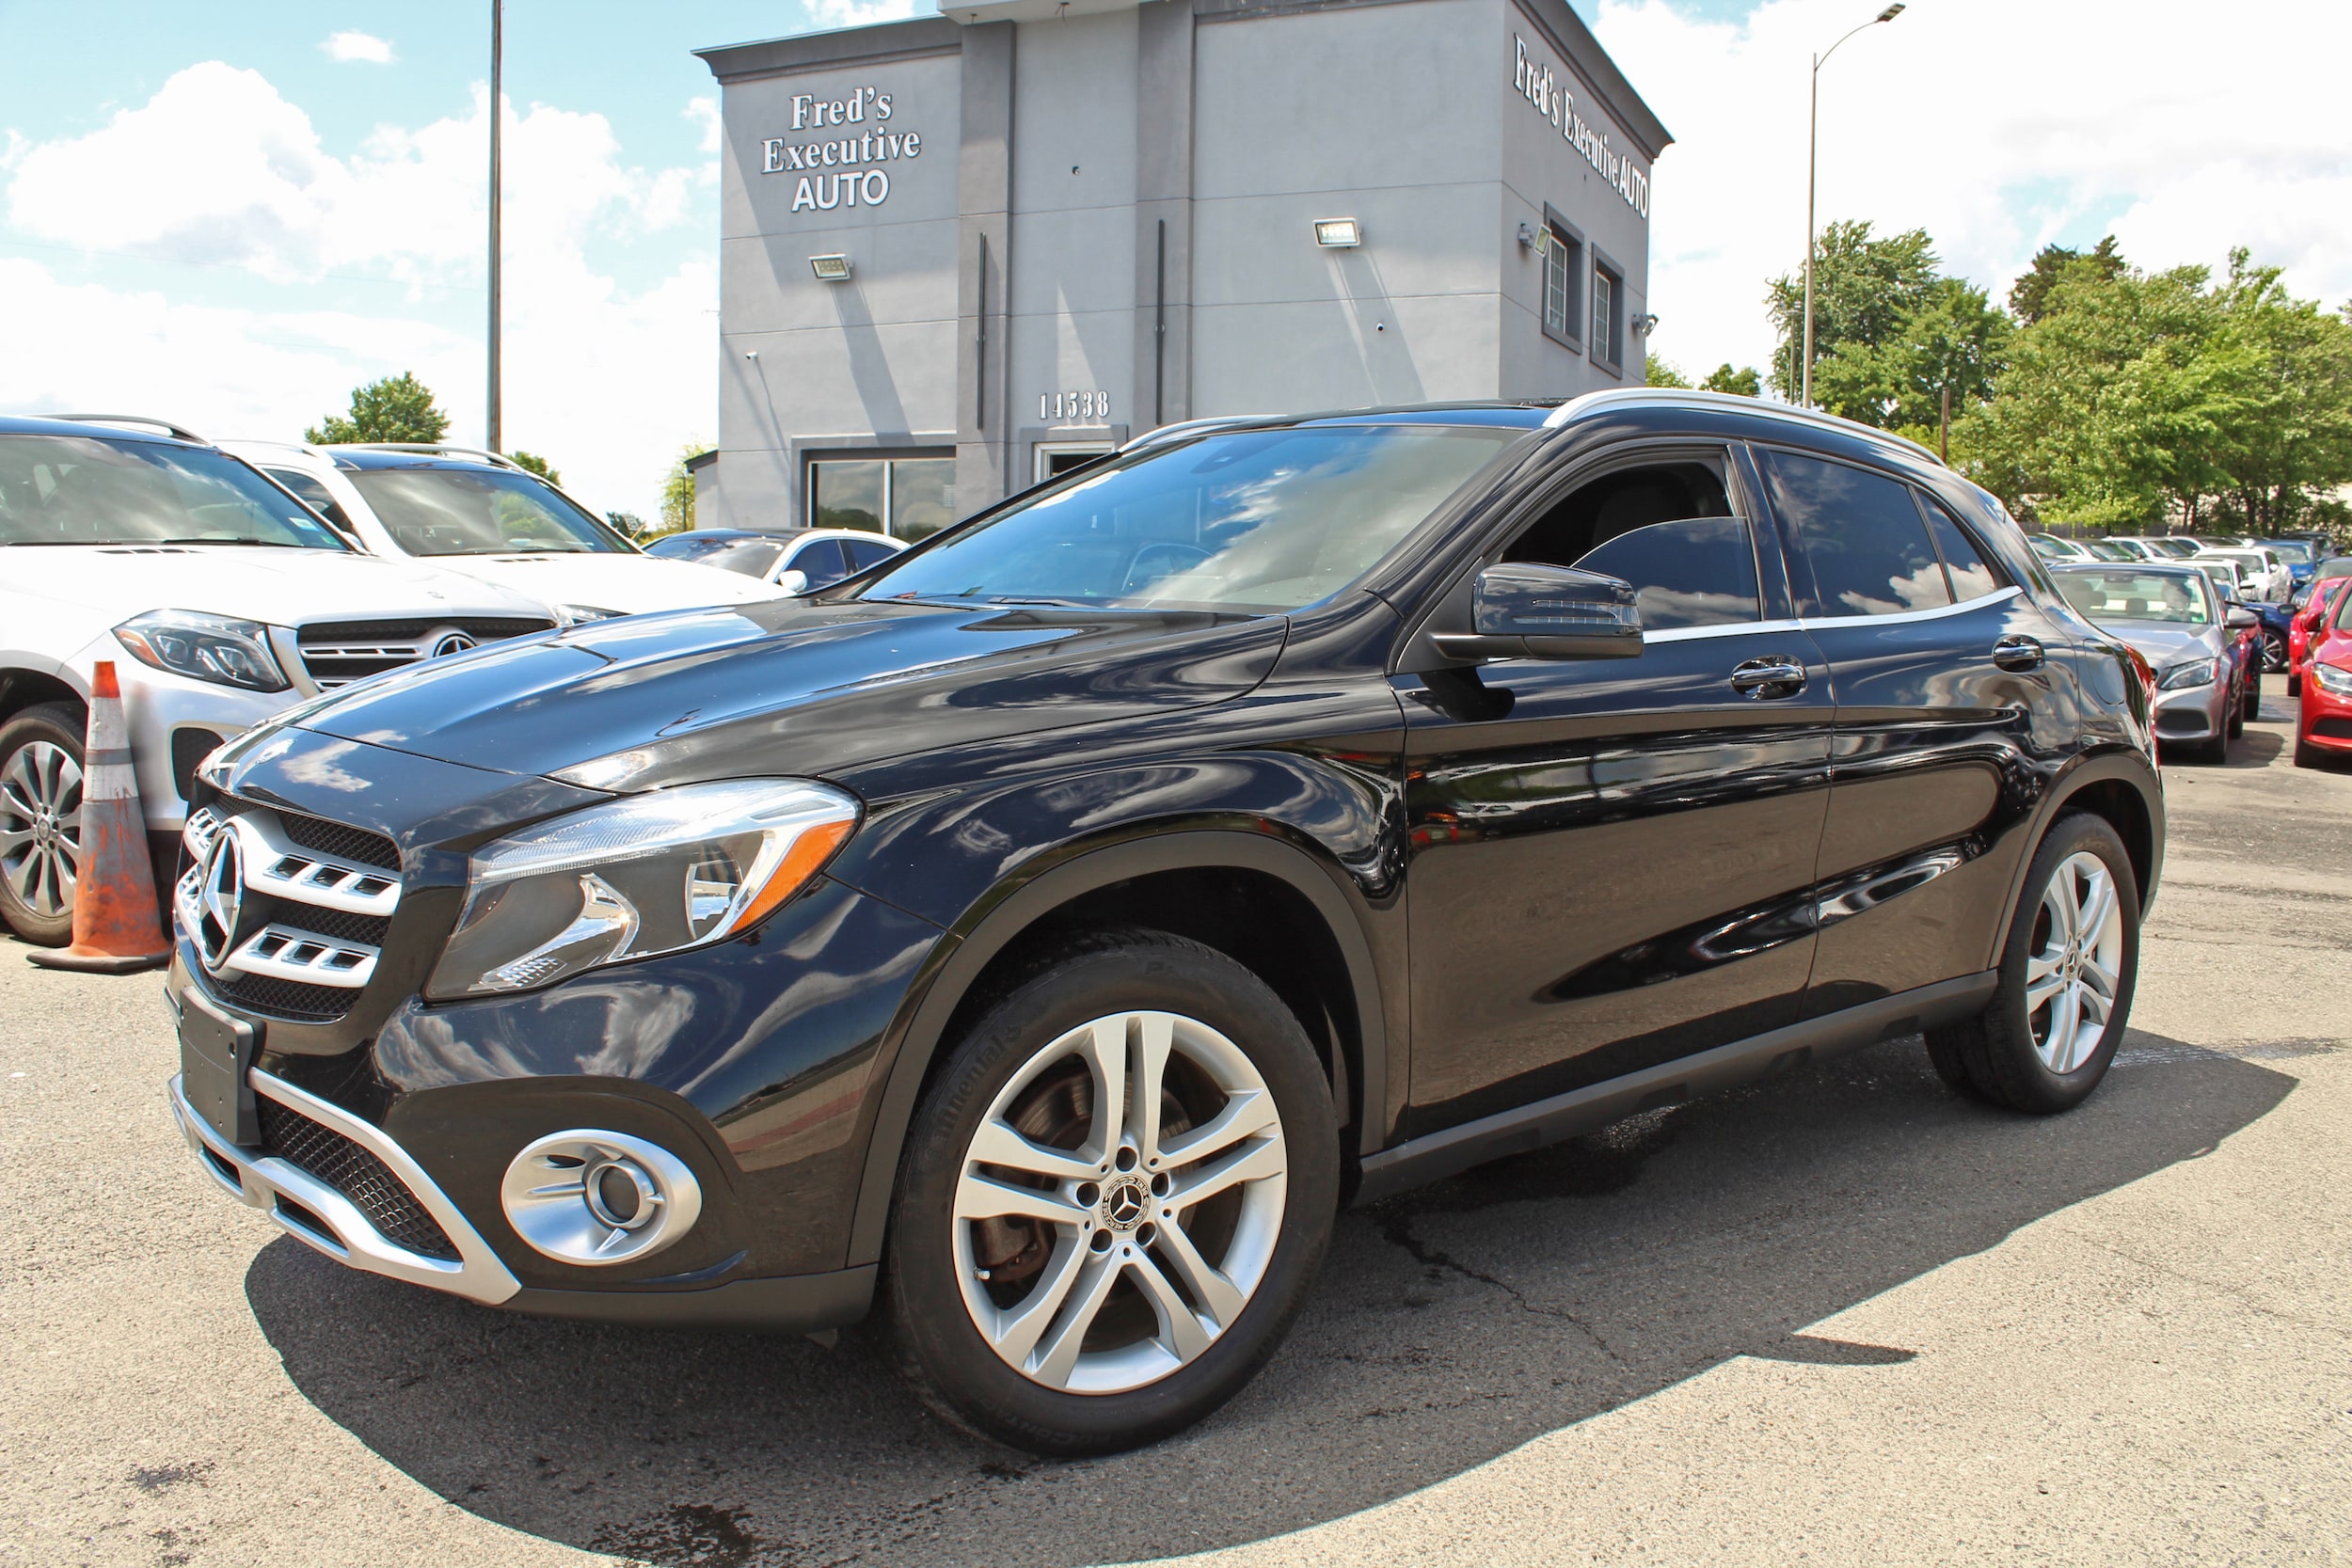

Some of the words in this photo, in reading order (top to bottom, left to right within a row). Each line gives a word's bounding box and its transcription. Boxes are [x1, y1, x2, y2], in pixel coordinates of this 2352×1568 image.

[789, 86, 893, 131] Fred's
[1514, 32, 1559, 128] Fred's
[1562, 87, 1618, 188] Executive
[1618, 154, 1648, 219] AUTO
[760, 126, 921, 174] Executive
[791, 168, 890, 213] AUTO
[1040, 390, 1109, 420] 14538
